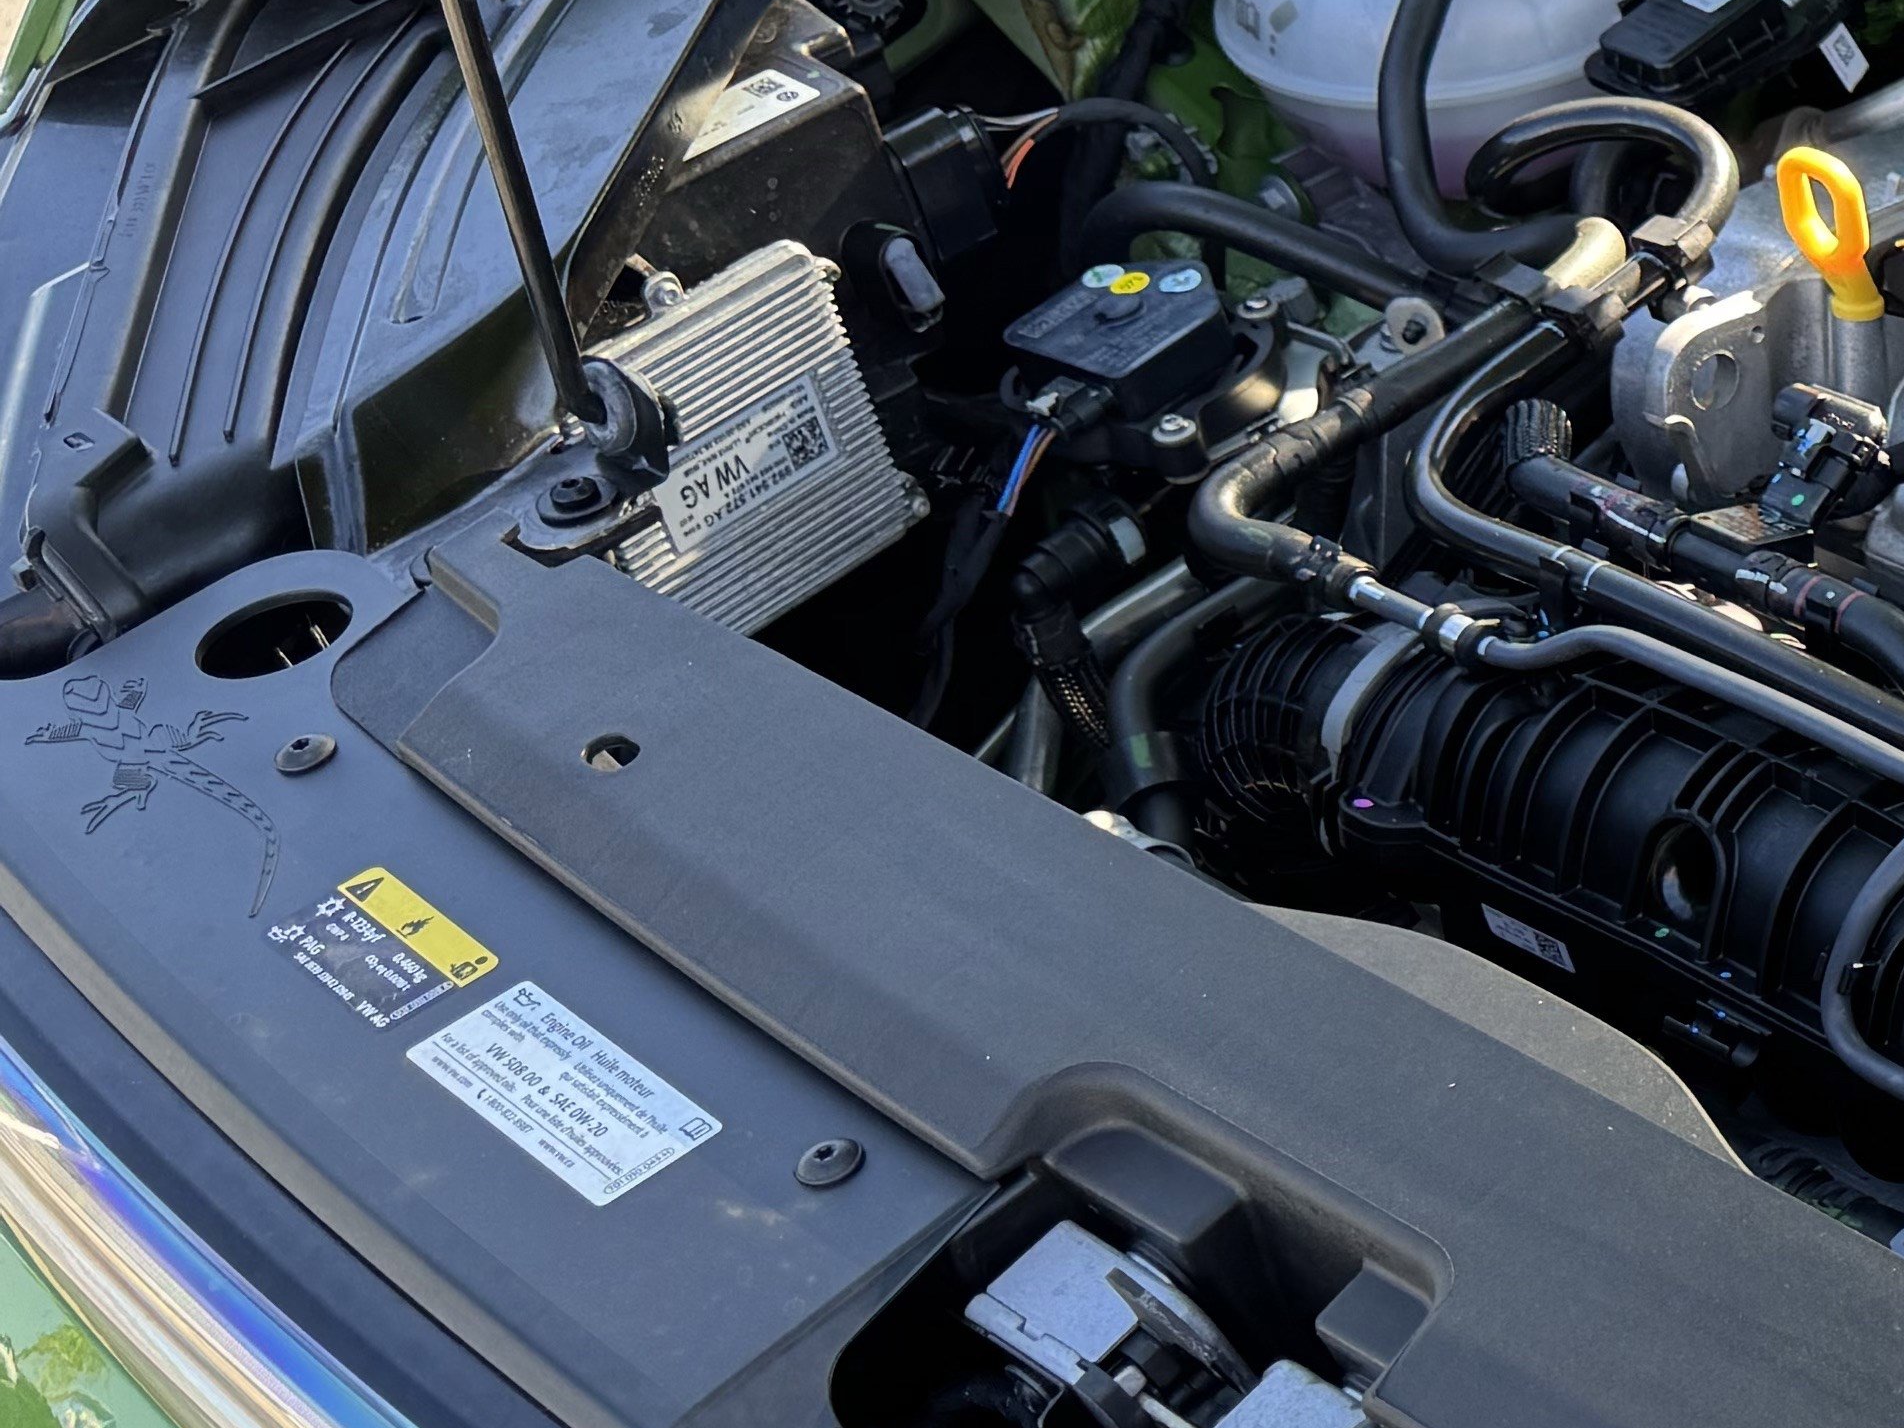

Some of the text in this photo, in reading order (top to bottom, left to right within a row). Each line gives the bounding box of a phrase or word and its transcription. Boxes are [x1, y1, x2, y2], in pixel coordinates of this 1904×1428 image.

[678, 472, 710, 509] AG
[714, 453, 750, 491] VW
[297, 934, 326, 955] PAG
[341, 910, 386, 943] R-1234yf
[354, 999, 390, 1028] VW AG
[539, 1011, 594, 1051] Engine Oil
[484, 1041, 609, 1138] VW 508 00 & SAE 0W-20
[589, 1048, 655, 1099] Huile moteur
